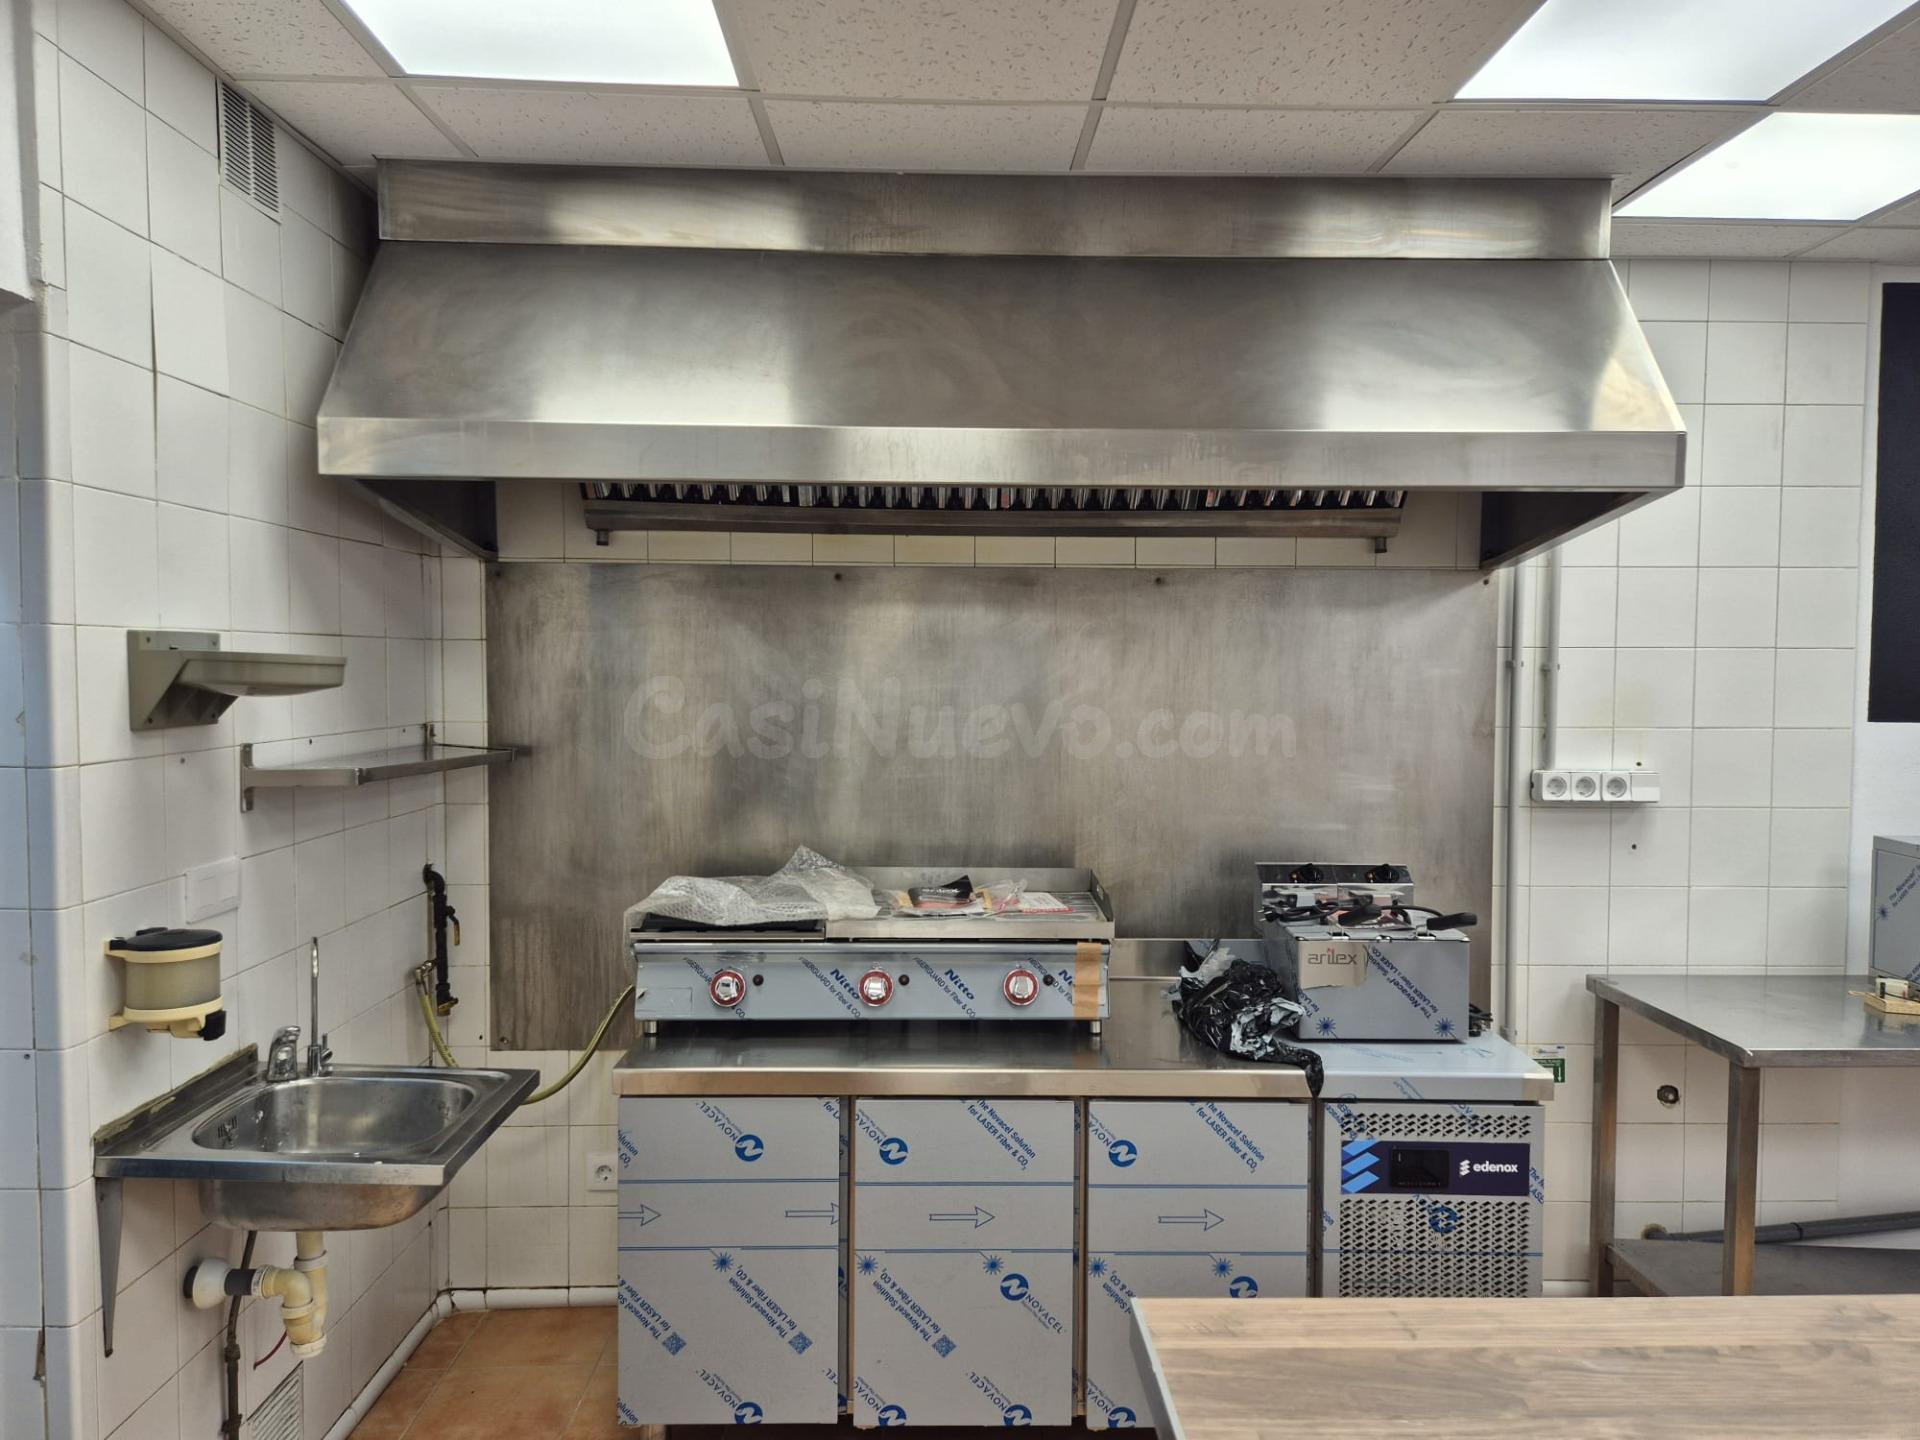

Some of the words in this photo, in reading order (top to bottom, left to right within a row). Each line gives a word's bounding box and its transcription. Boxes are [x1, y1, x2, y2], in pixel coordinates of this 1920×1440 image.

[1307, 948, 1357, 965] arilex
[1368, 955, 1389, 976] Solutio
[830, 968, 860, 1000] Nitto
[944, 968, 975, 1000] Nitto
[700, 1100, 738, 1141] NOVACEL
[855, 1114, 883, 1144] NOVAC
[968, 1104, 979, 1116] for
[976, 1114, 999, 1137] LASER
[995, 1133, 1013, 1152] Fiber
[618, 1131, 639, 1156] olution
[987, 1108, 1014, 1135] Novacel
[1010, 1131, 1036, 1159] Solution
[1088, 1121, 1112, 1147] NOVA
[1196, 1107, 1207, 1119] for
[1205, 1117, 1228, 1139] LASER
[1225, 1137, 1242, 1154] Fiber
[1240, 1152, 1248, 1160] &
[1216, 1111, 1242, 1137] Novacel
[1239, 1135, 1265, 1162] Solution
[1472, 1160, 1518, 1173] edenox
[625, 1285, 643, 1302] Fiber
[729, 1277, 754, 1304] Solution
[751, 1284, 768, 1302] Fiber
[872, 1280, 899, 1308] Solution
[896, 1287, 912, 1305] Fiber
[1103, 1282, 1127, 1309] Solution
[624, 1303, 651, 1328] Novacel
[639, 1299, 662, 1322] LASER
[750, 1301, 777, 1328] Novacel
[766, 1299, 788, 1321] LASER
[894, 1304, 921, 1331] Novacel
[910, 1301, 932, 1325] LASER
[1025, 1294, 1063, 1334] NOVACEL
[649, 1325, 662, 1340] The
[660, 1320, 672, 1331] for
[776, 1324, 788, 1338] The
[786, 1319, 797, 1331] for
[919, 1328, 932, 1342] The
[931, 1322, 942, 1334] for
[699, 1369, 738, 1408] NOVACEL
[969, 1371, 1007, 1412] NOVACEL
[1087, 1388, 1111, 1413] NOVA
[617, 1400, 638, 1423] olution
